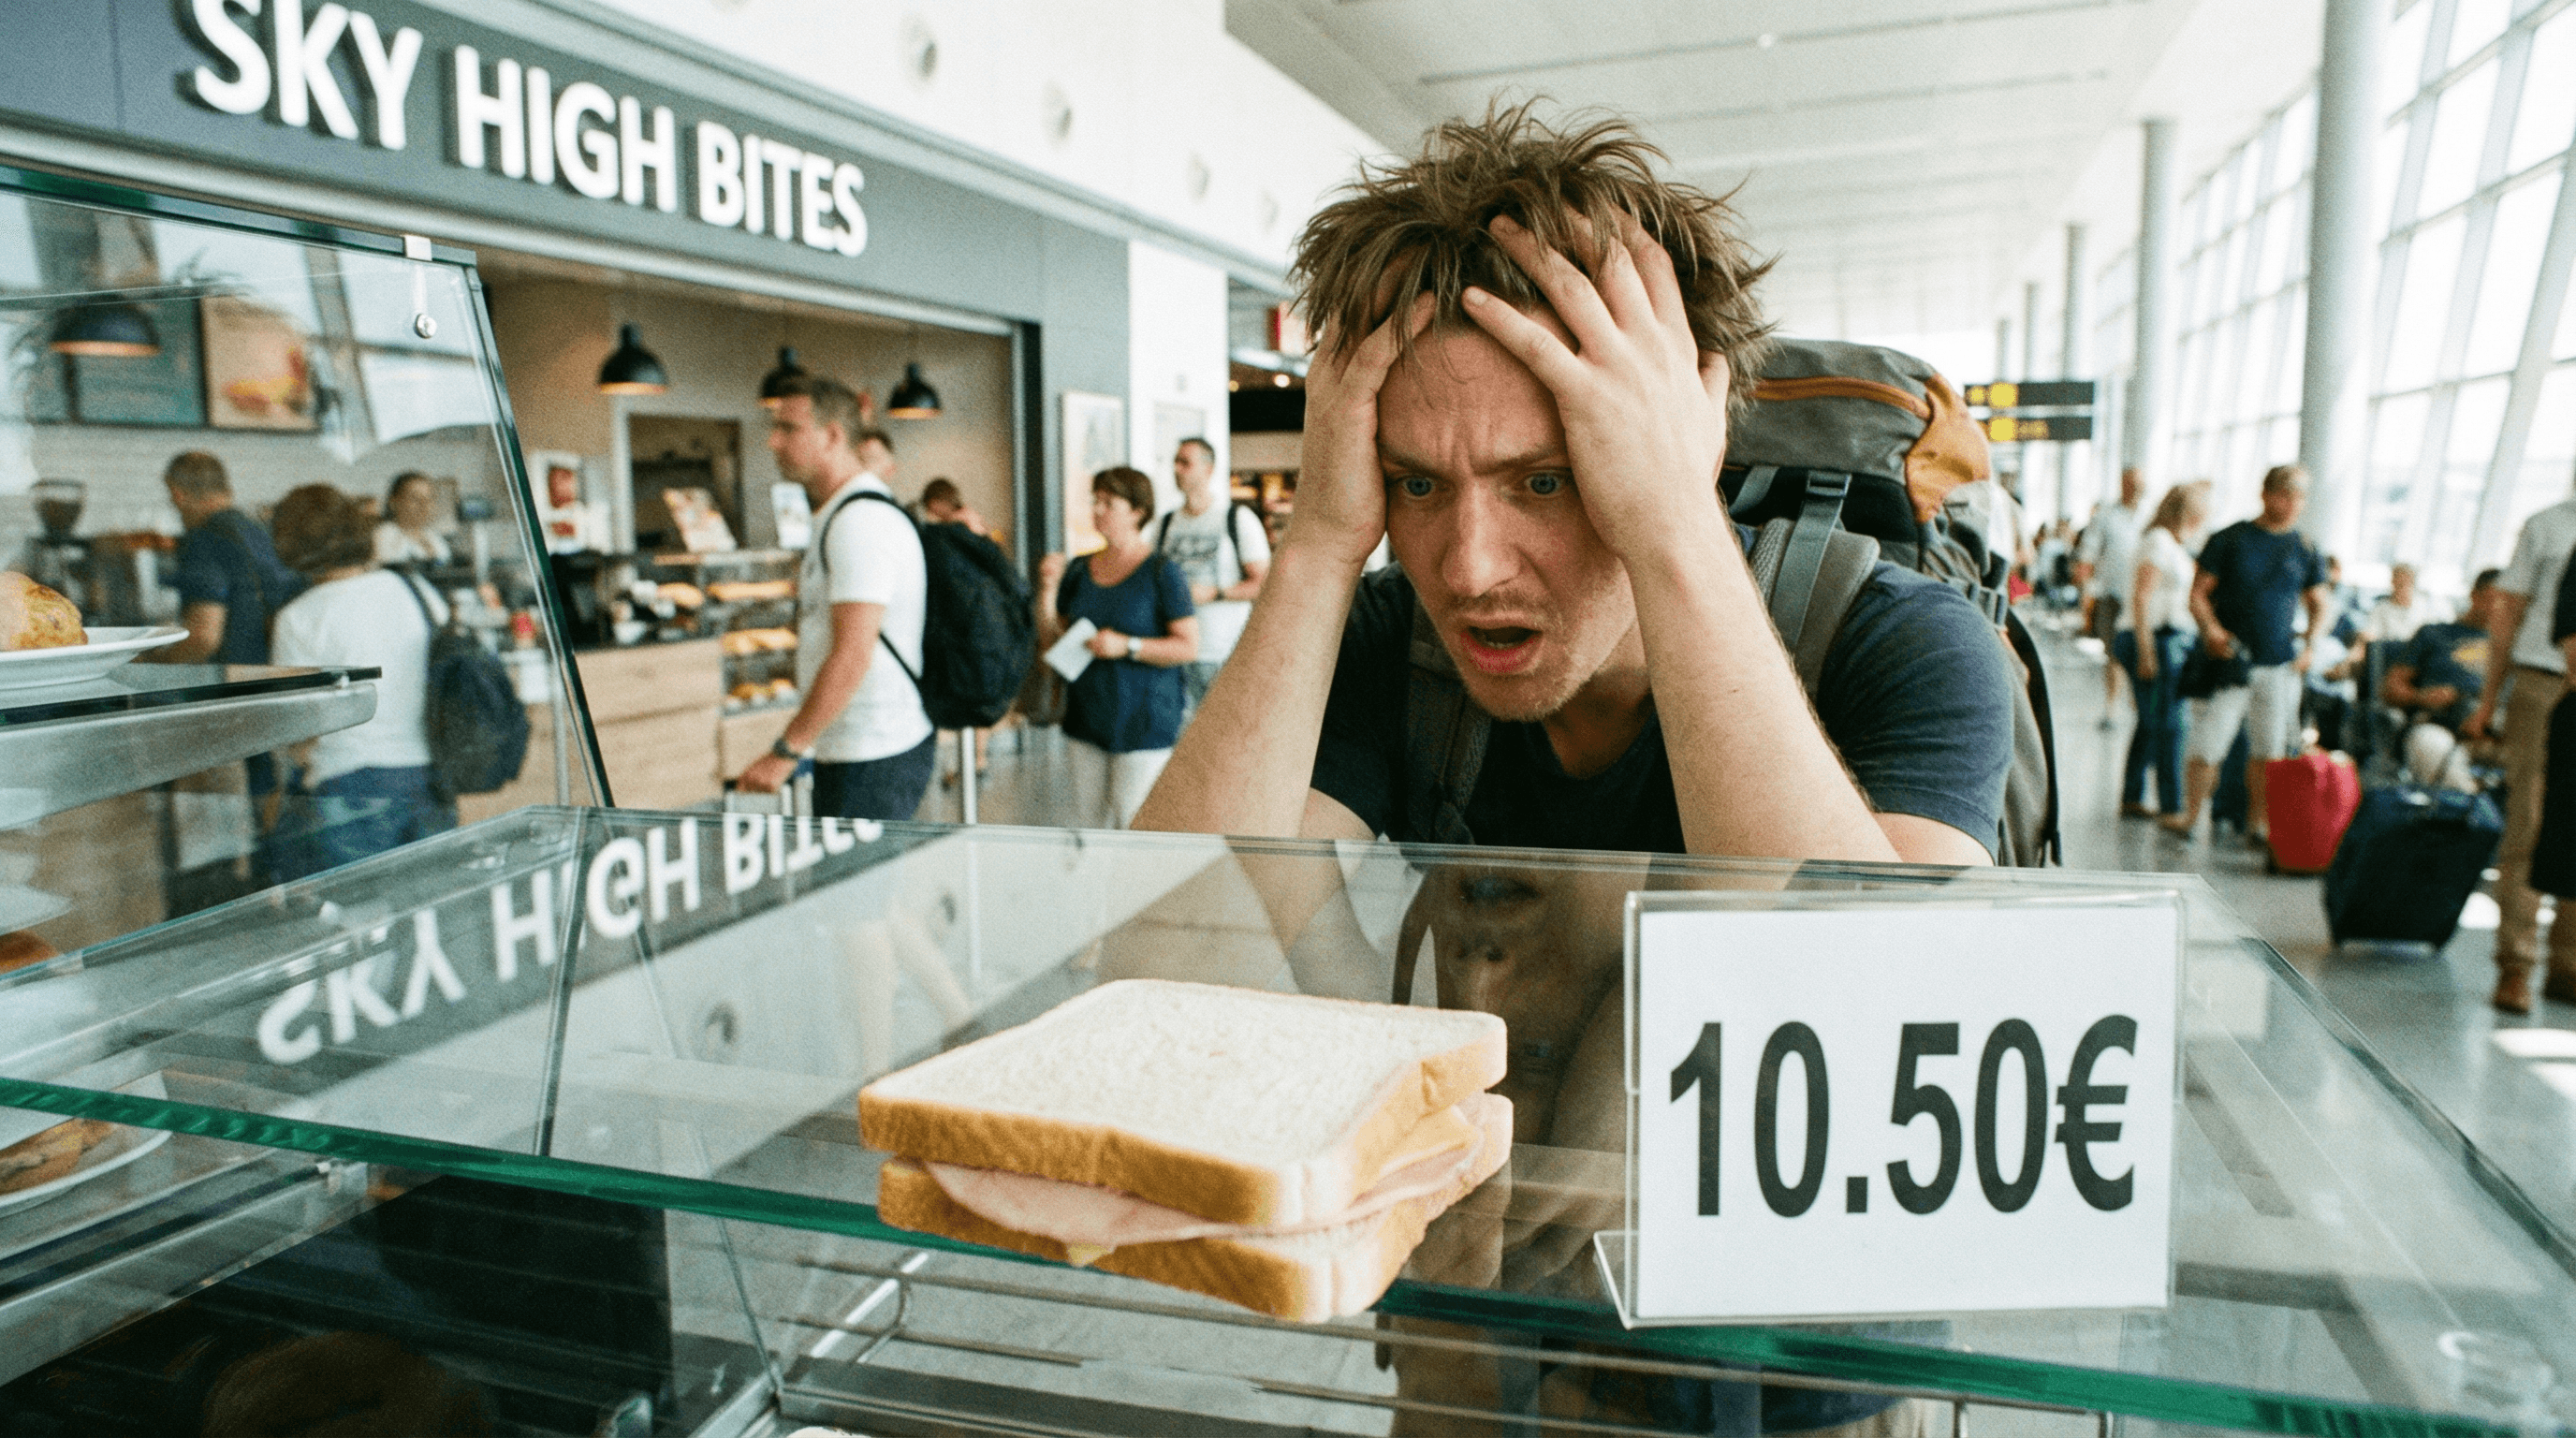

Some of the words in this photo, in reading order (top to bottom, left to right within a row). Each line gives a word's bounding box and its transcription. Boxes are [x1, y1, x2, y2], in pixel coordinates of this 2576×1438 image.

[193, 0, 423, 151] SKY
[454, 44, 678, 214] HIGH
[696, 120, 869, 257] BITES
[1670, 1014, 2139, 1218] 10.50€
